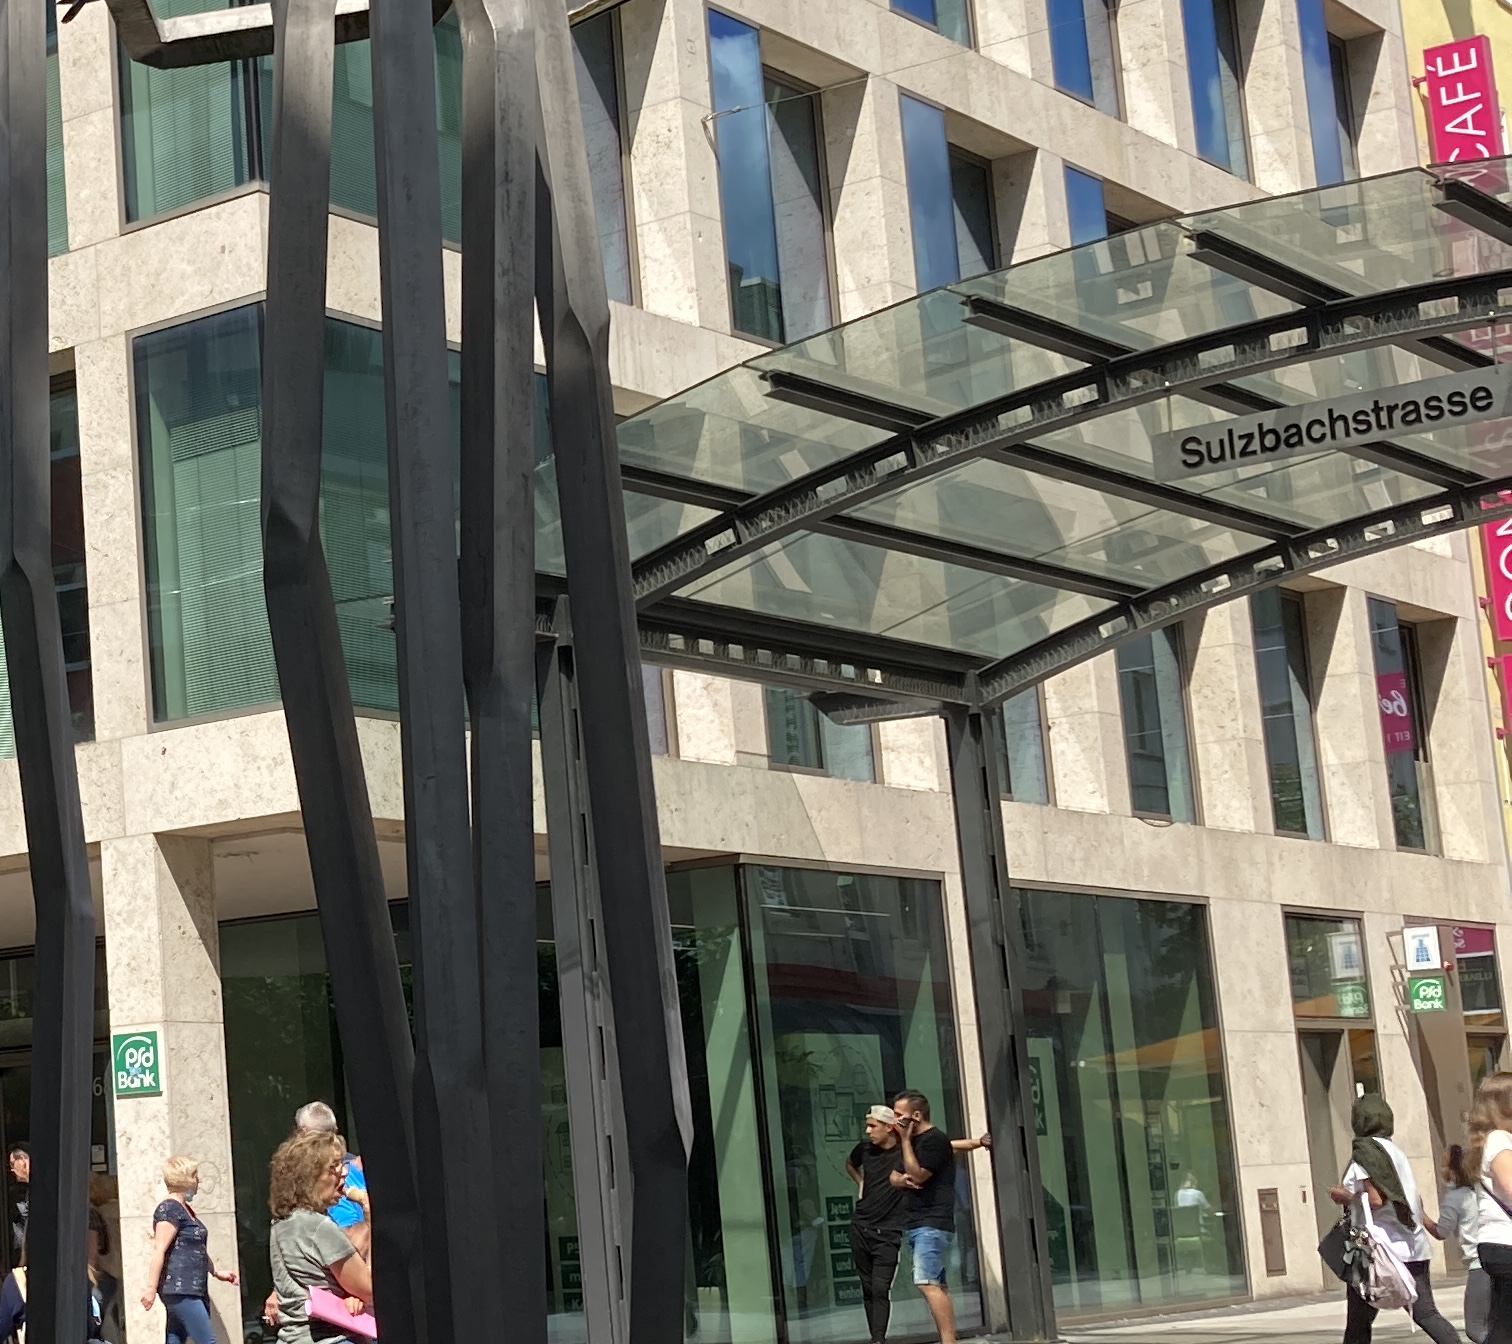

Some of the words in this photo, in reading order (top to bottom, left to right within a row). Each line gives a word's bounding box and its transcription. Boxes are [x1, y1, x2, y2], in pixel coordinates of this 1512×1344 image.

[1180, 385, 1495, 470] Sulzbachstrasse
[1413, 997, 1444, 1011] Bank
[124, 1046, 155, 1069] psd
[117, 1069, 157, 1089] Bank
